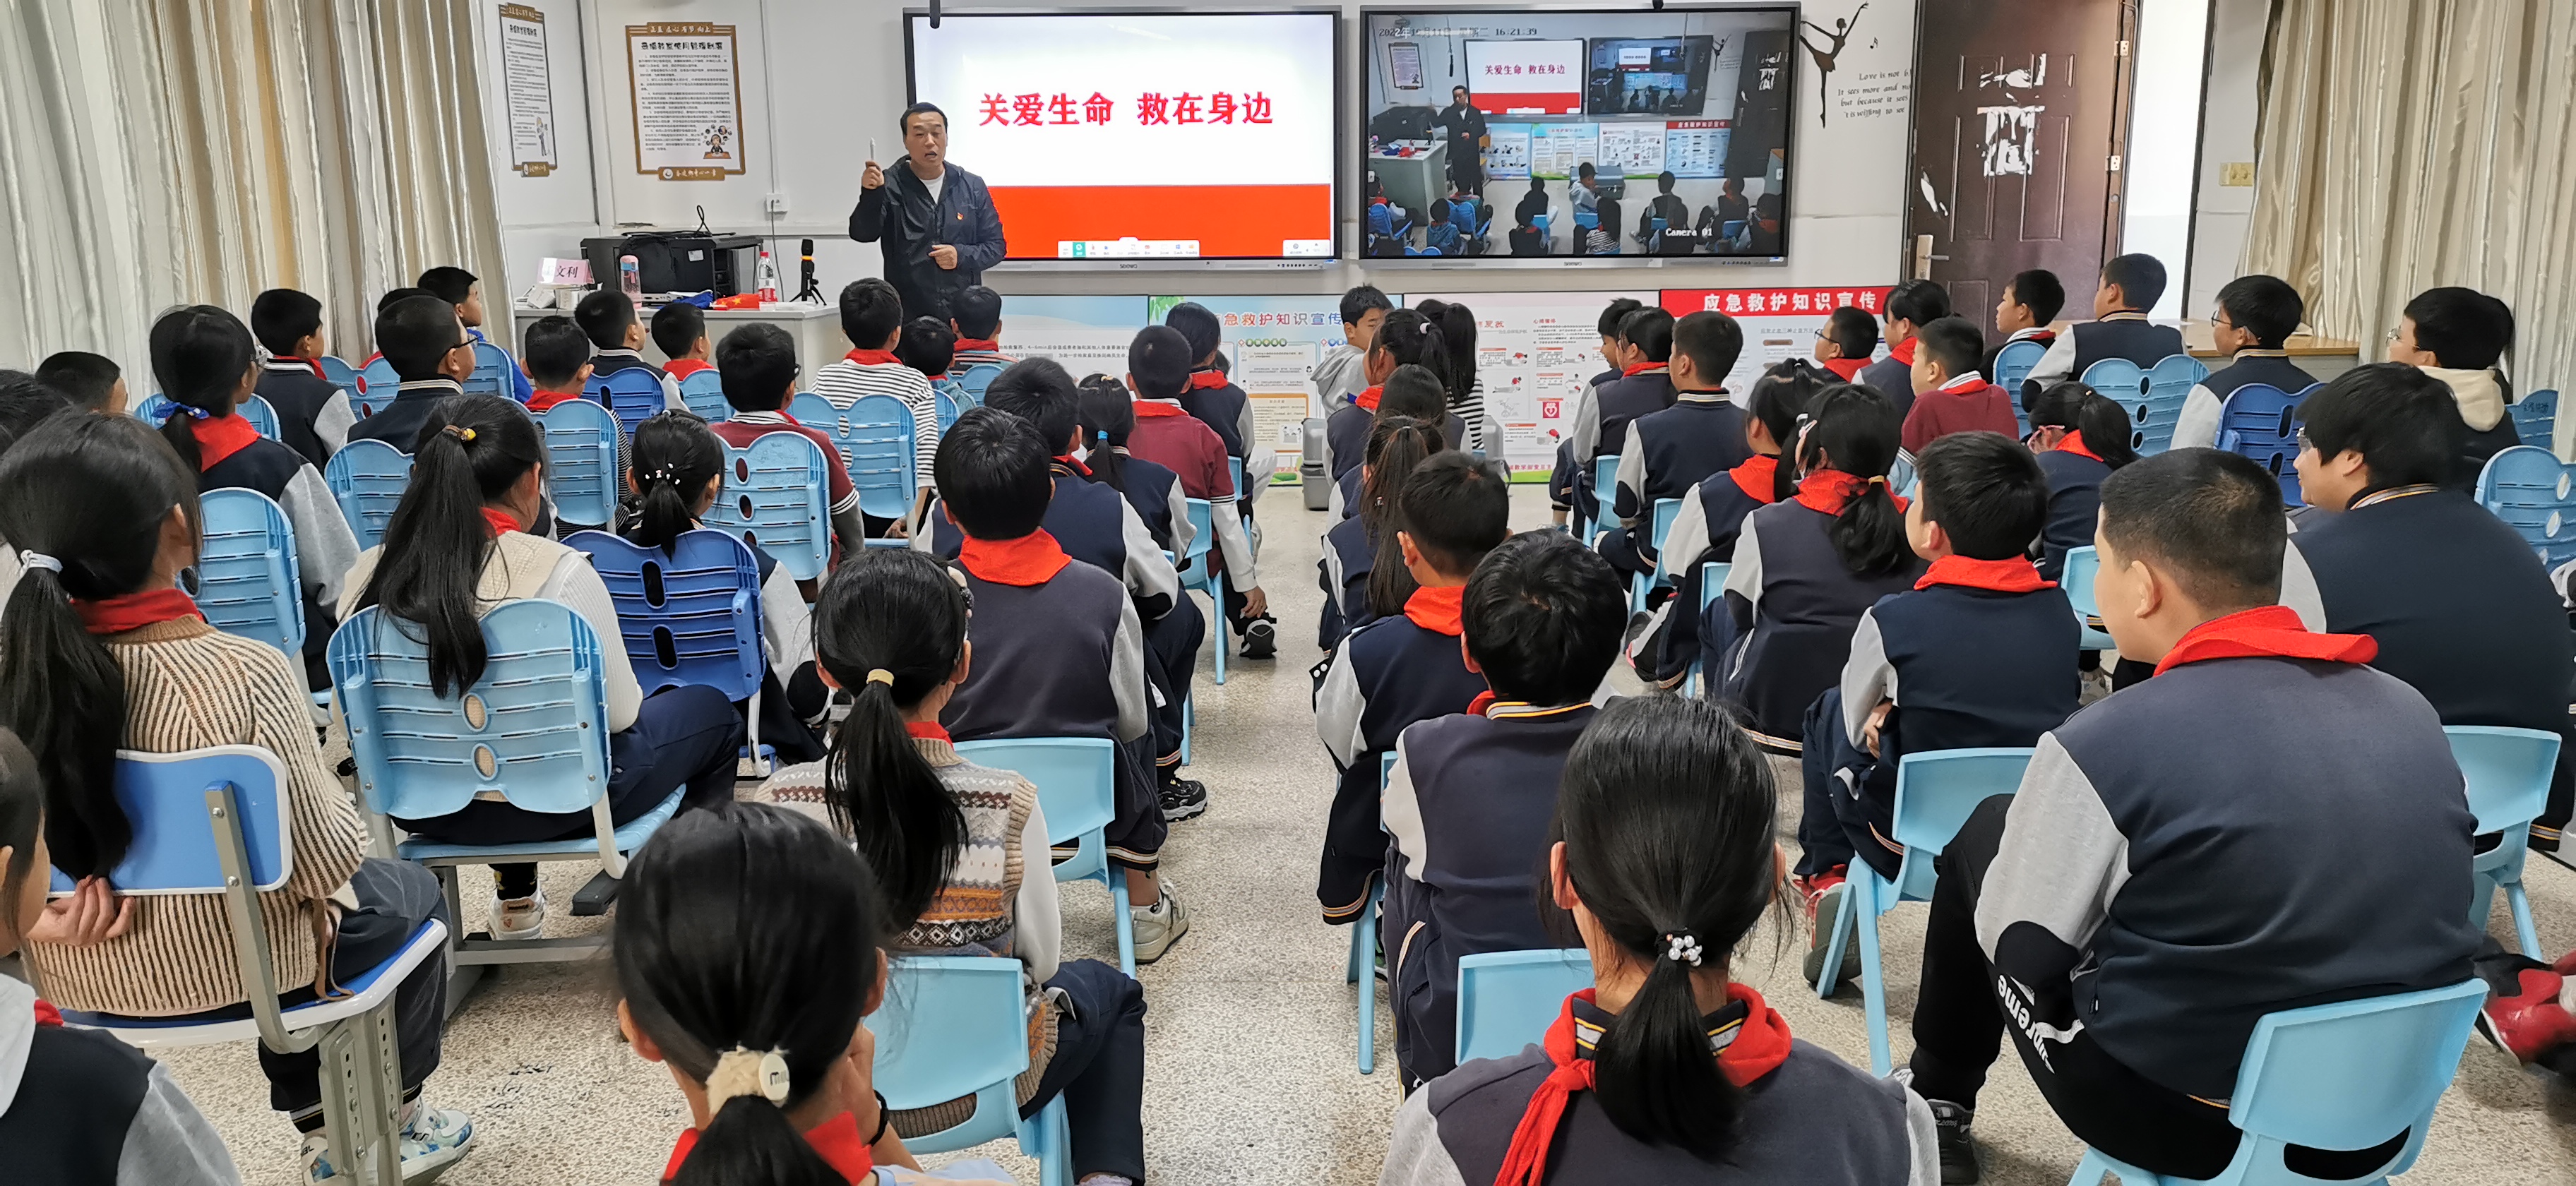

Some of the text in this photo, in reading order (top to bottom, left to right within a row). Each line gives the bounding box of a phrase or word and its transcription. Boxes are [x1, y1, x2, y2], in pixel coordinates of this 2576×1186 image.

[1485, 64, 1566, 75] 关爱生命 救在身边
[1883, 83, 1899, 92] and
[979, 92, 1273, 126] 关爱生命 救在身边
[1665, 228, 1712, 237] Camera 01
[1703, 291, 1876, 312] 应急救护知识宣传
[1217, 312, 1342, 325] 急救护知识宣传
